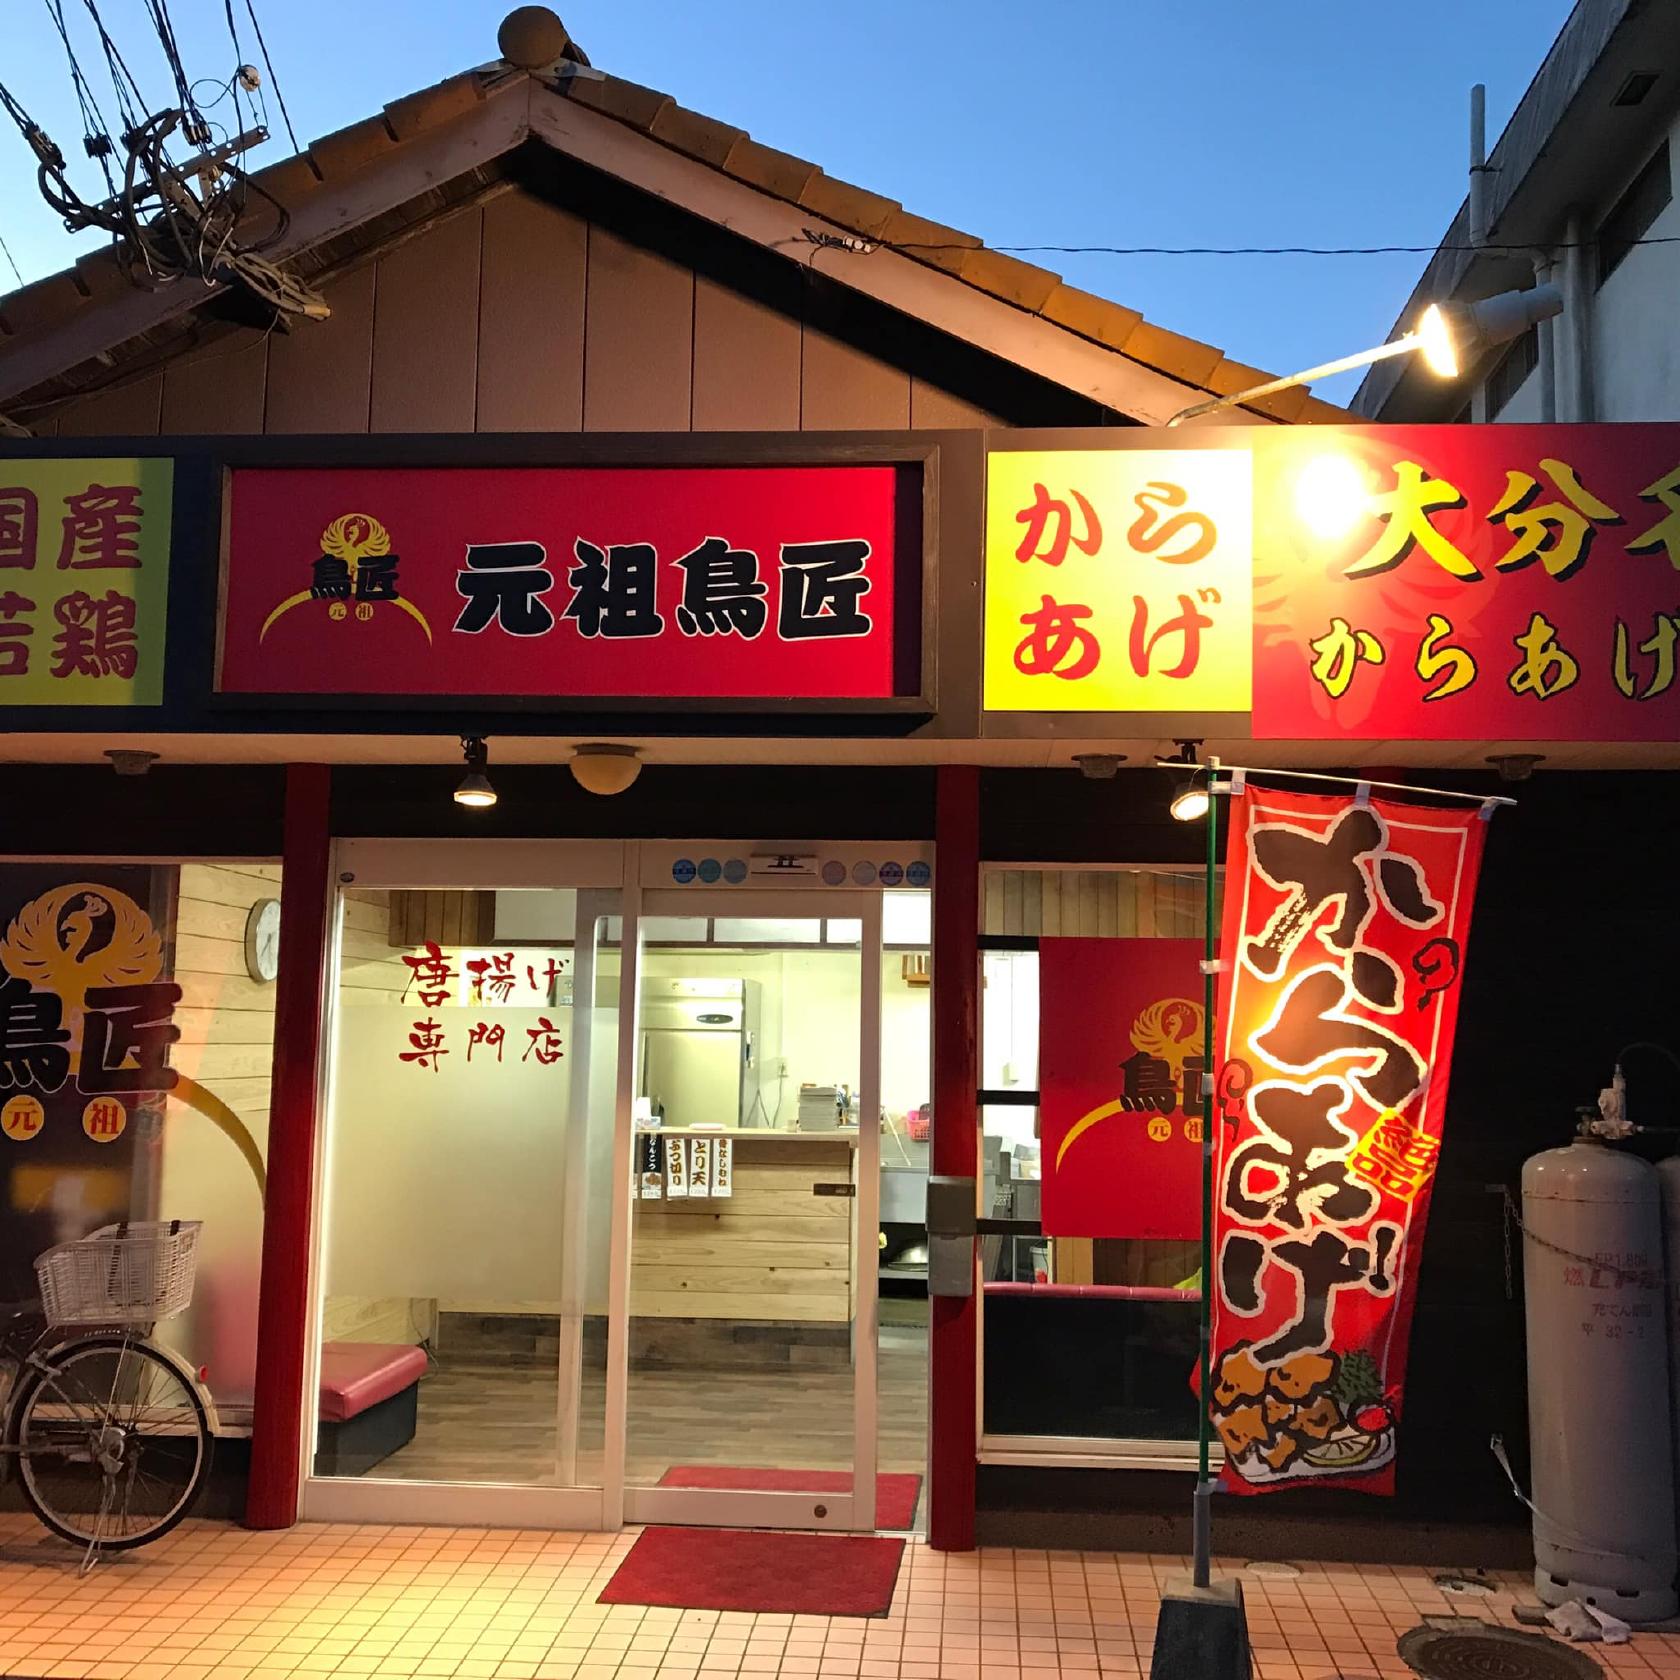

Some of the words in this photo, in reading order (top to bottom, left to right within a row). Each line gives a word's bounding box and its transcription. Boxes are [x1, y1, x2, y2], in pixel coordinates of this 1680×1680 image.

[1015, 482, 1217, 567] から
[311, 554, 400, 601] 鳥匠
[453, 536, 872, 641] 元祖鳥匠
[1013, 587, 1222, 680] あげ
[400, 940, 570, 1008] 唐揚げ
[398, 1016, 564, 1073] 専門店
[7, 1101, 119, 1135] 元祖
[1217, 804, 1445, 1369] からあげ
[691, 1140, 707, 1186] とり天
